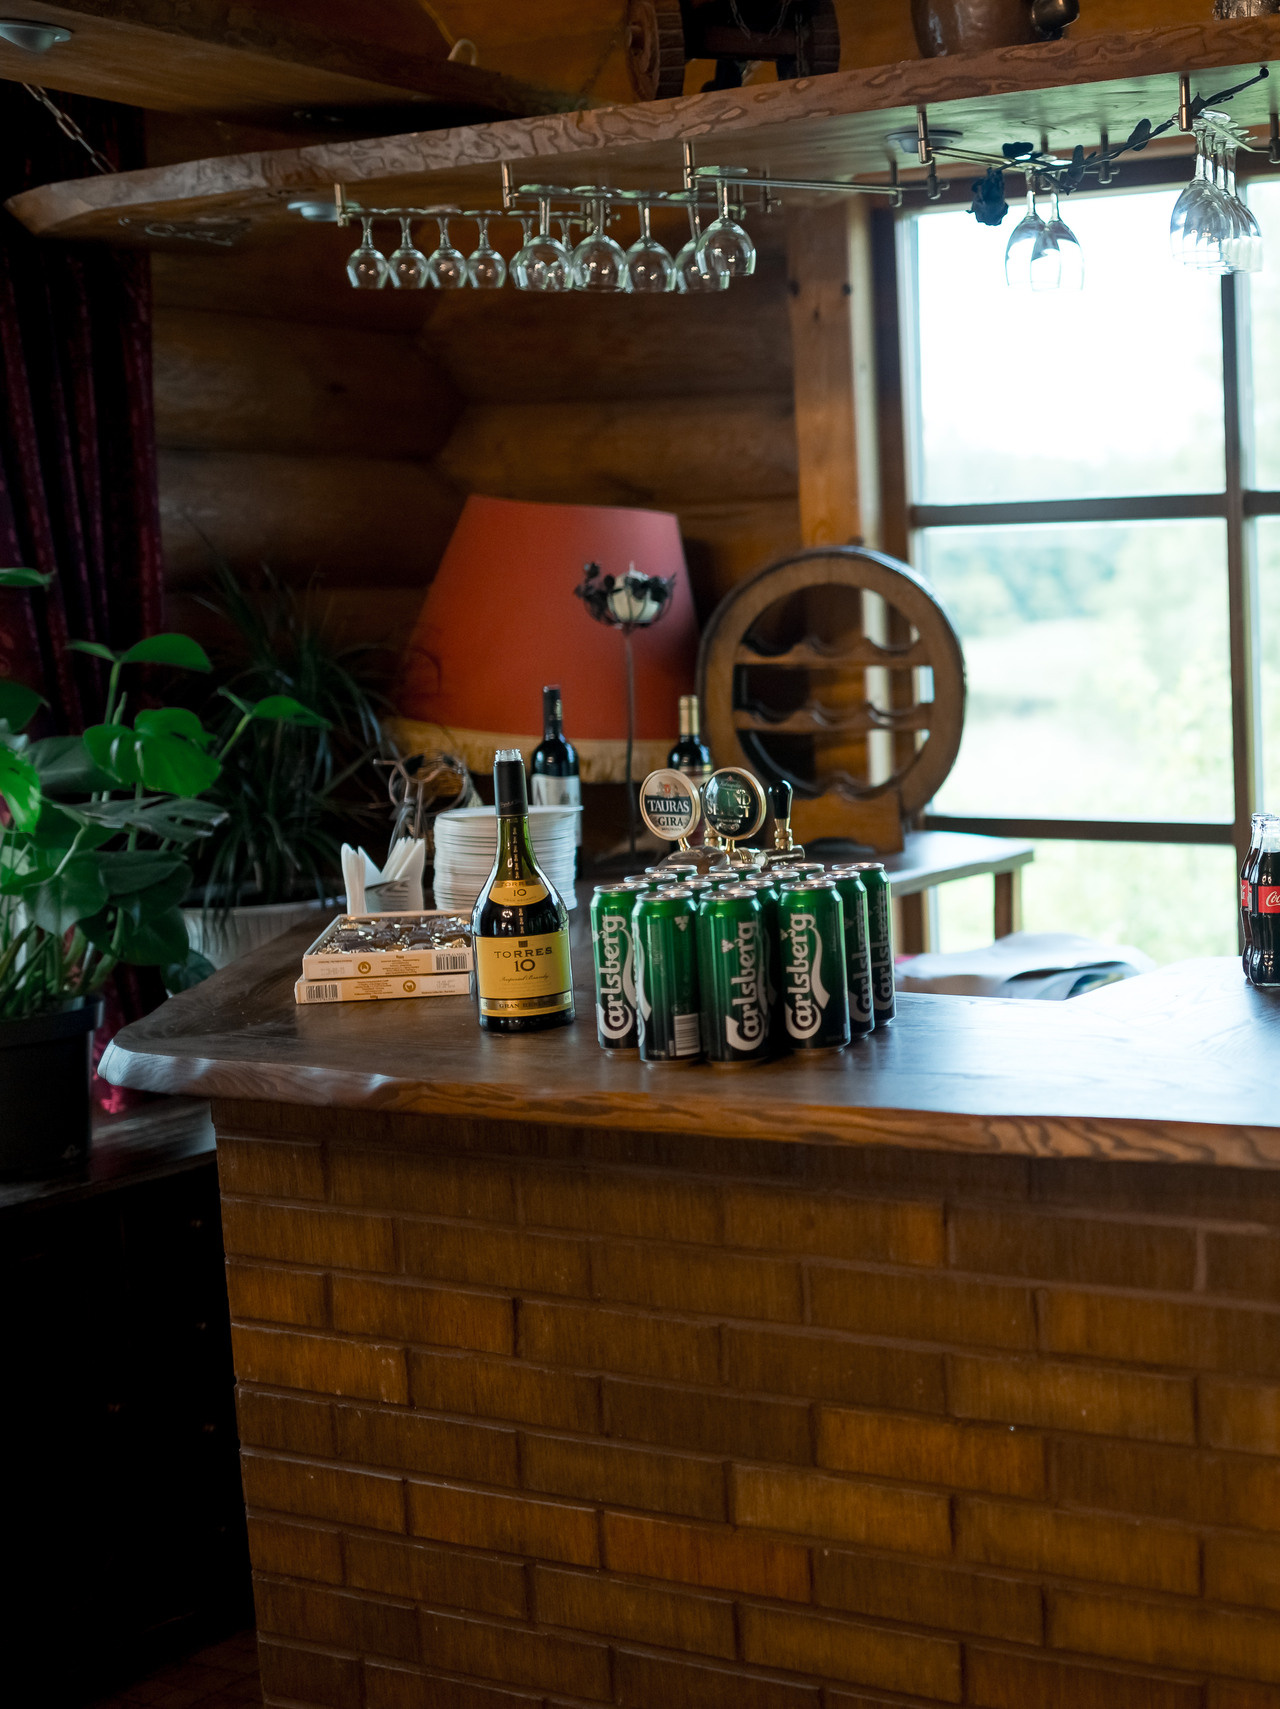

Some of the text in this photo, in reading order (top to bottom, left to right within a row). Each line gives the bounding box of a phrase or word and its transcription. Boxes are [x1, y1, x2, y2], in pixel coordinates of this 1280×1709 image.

[647, 799, 690, 813] TAURAS
[658, 816, 684, 827] GIRA
[513, 888, 527, 897] 10
[494, 946, 553, 959] TORRES
[514, 959, 536, 973] 10
[596, 914, 637, 1040] Carlsberg
[783, 912, 831, 1040] Carlsberg
[725, 921, 769, 1051] Carlsberg
